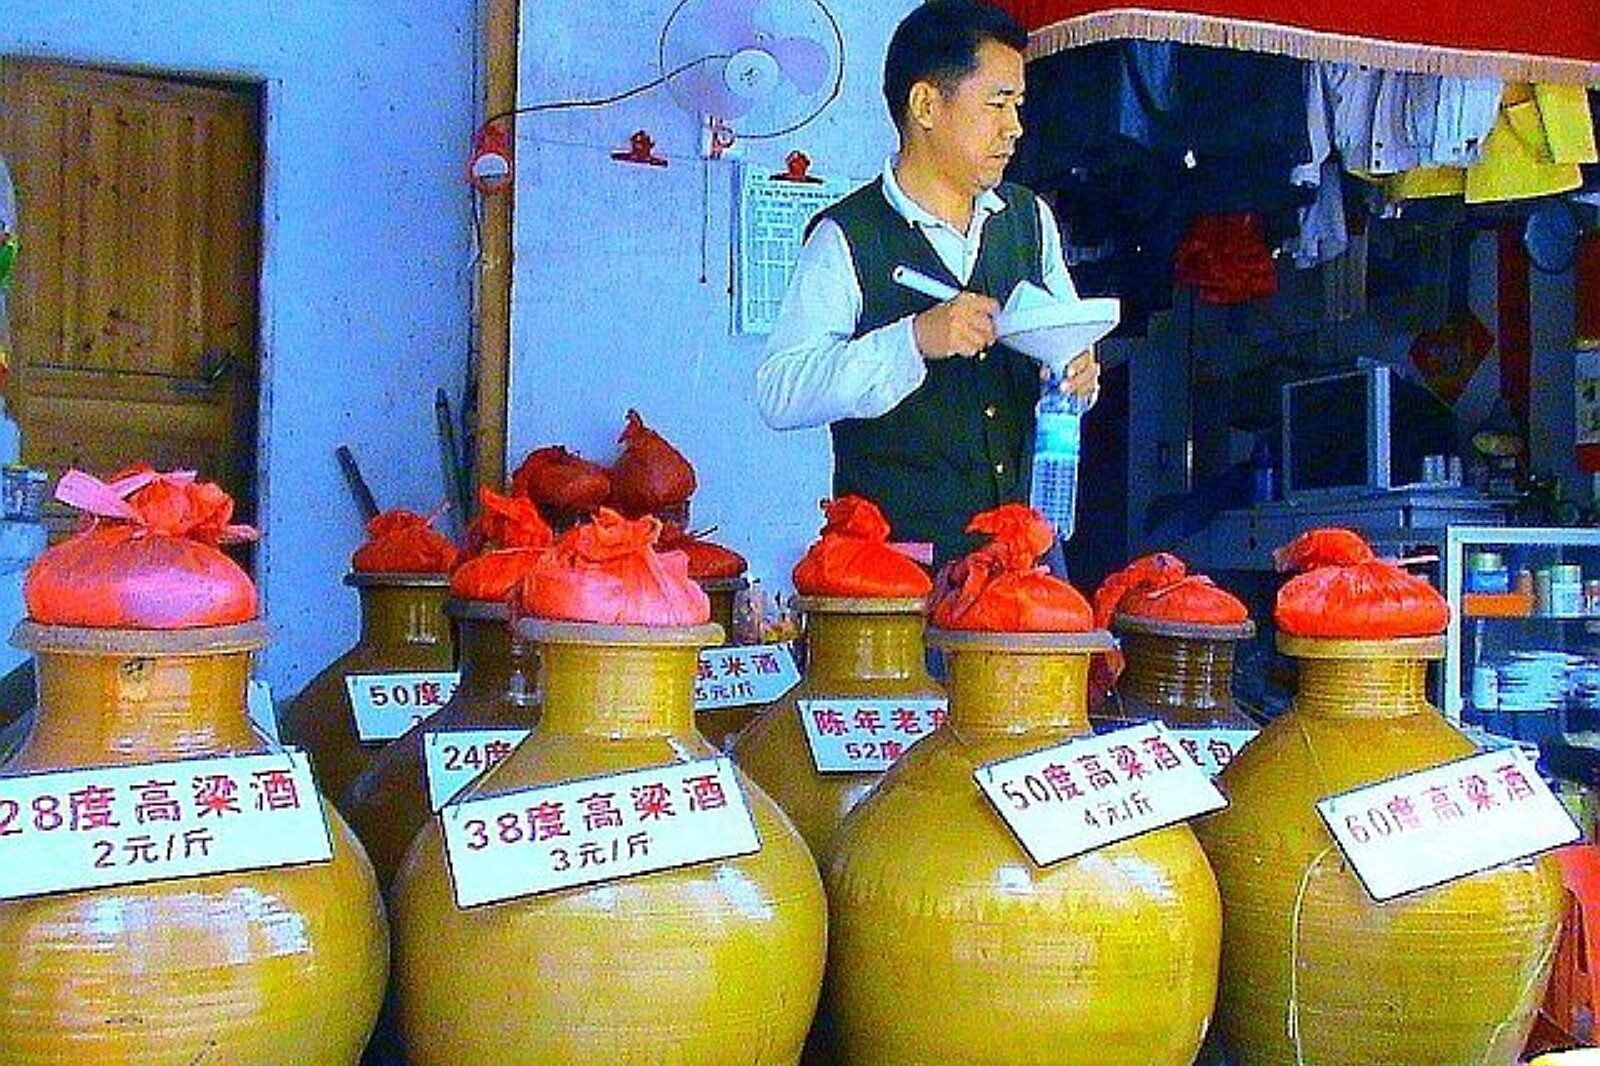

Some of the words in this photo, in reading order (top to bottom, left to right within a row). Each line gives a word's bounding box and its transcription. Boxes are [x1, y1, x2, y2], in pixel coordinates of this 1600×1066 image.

[369, 681, 459, 706] 50度
[0, 768, 301, 835] 28度高粱酒
[1001, 734, 1181, 810] 50度高粱酒
[1344, 763, 1536, 844] 60度高粱酒
[463, 774, 729, 851] 38度高粱酒
[94, 827, 214, 868] 2元/斤
[549, 831, 655, 873] 3元/斤
